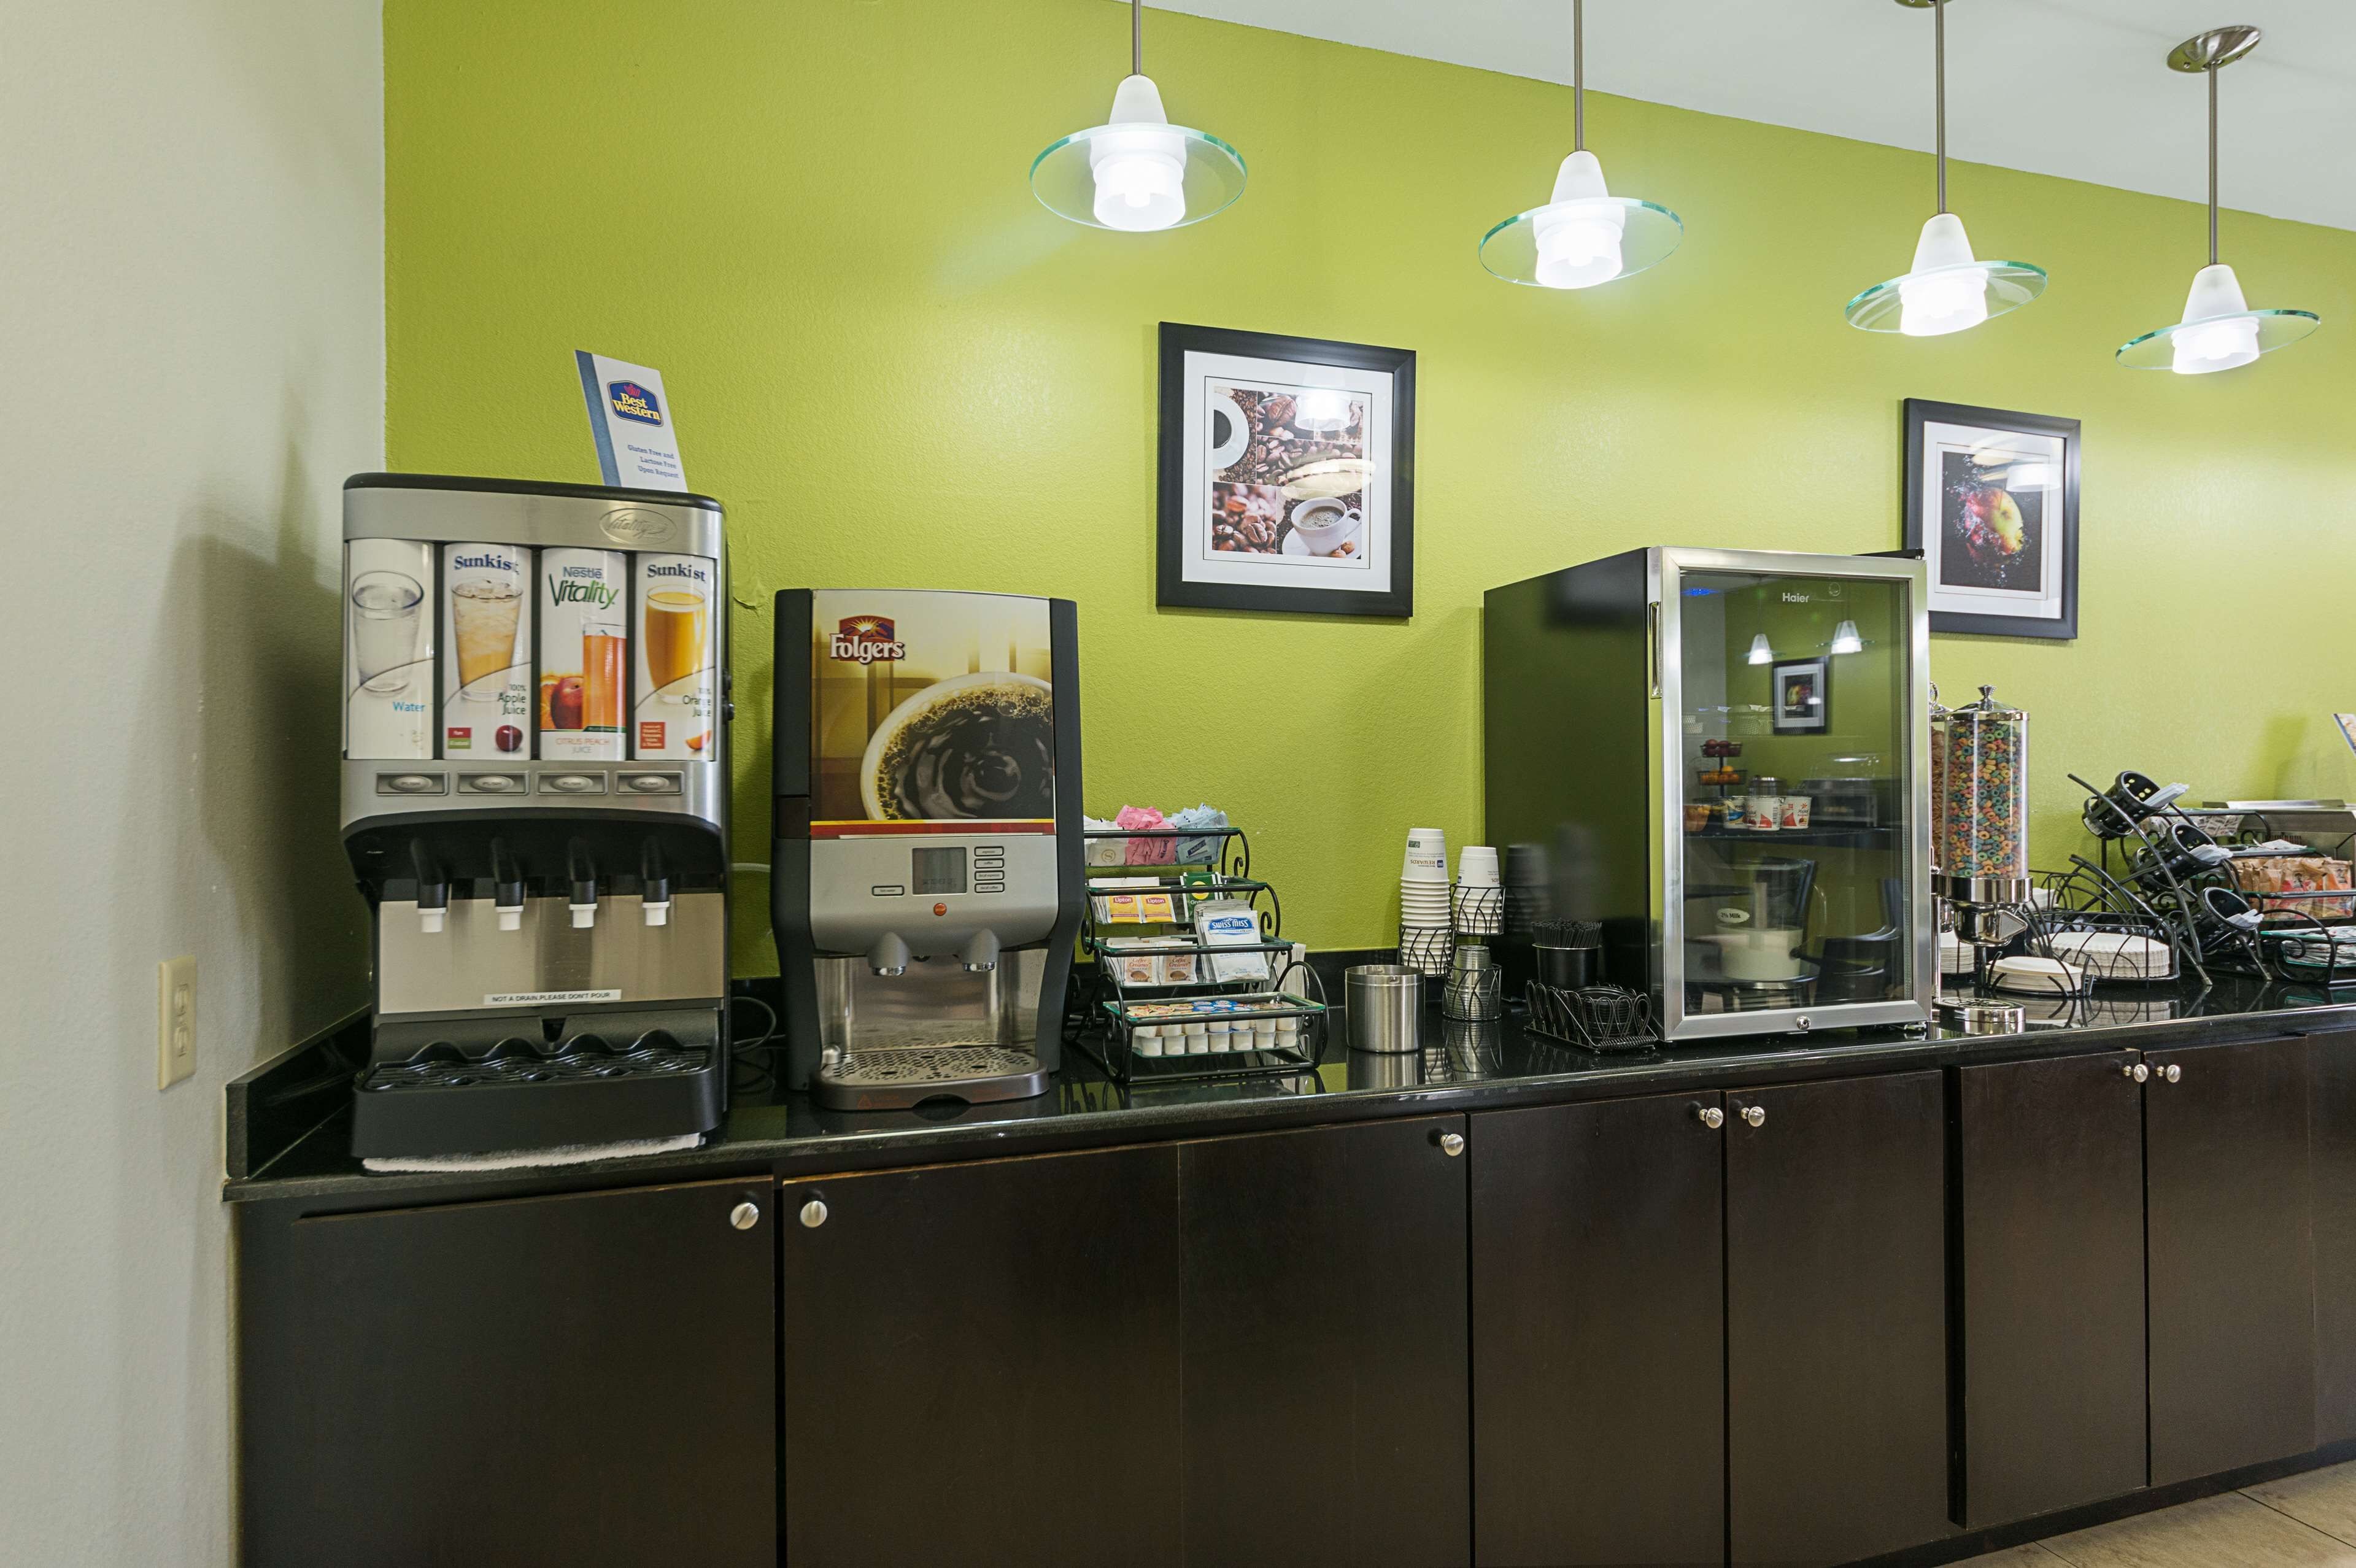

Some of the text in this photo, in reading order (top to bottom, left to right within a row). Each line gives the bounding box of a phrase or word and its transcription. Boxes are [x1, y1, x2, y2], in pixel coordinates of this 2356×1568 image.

[620, 393, 648, 409] Best
[612, 400, 661, 420] Western
[628, 444, 648, 454] Gluten
[647, 563, 706, 581] Sunkist
[549, 573, 619, 609] Vitality
[1782, 592, 1809, 603] Haier
[829, 633, 905, 664] Folgers
[497, 692, 526, 706] Apple
[682, 695, 711, 706] Orae
[392, 701, 425, 712] Water
[502, 706, 526, 715] Juice
[692, 707, 711, 717] Jue
